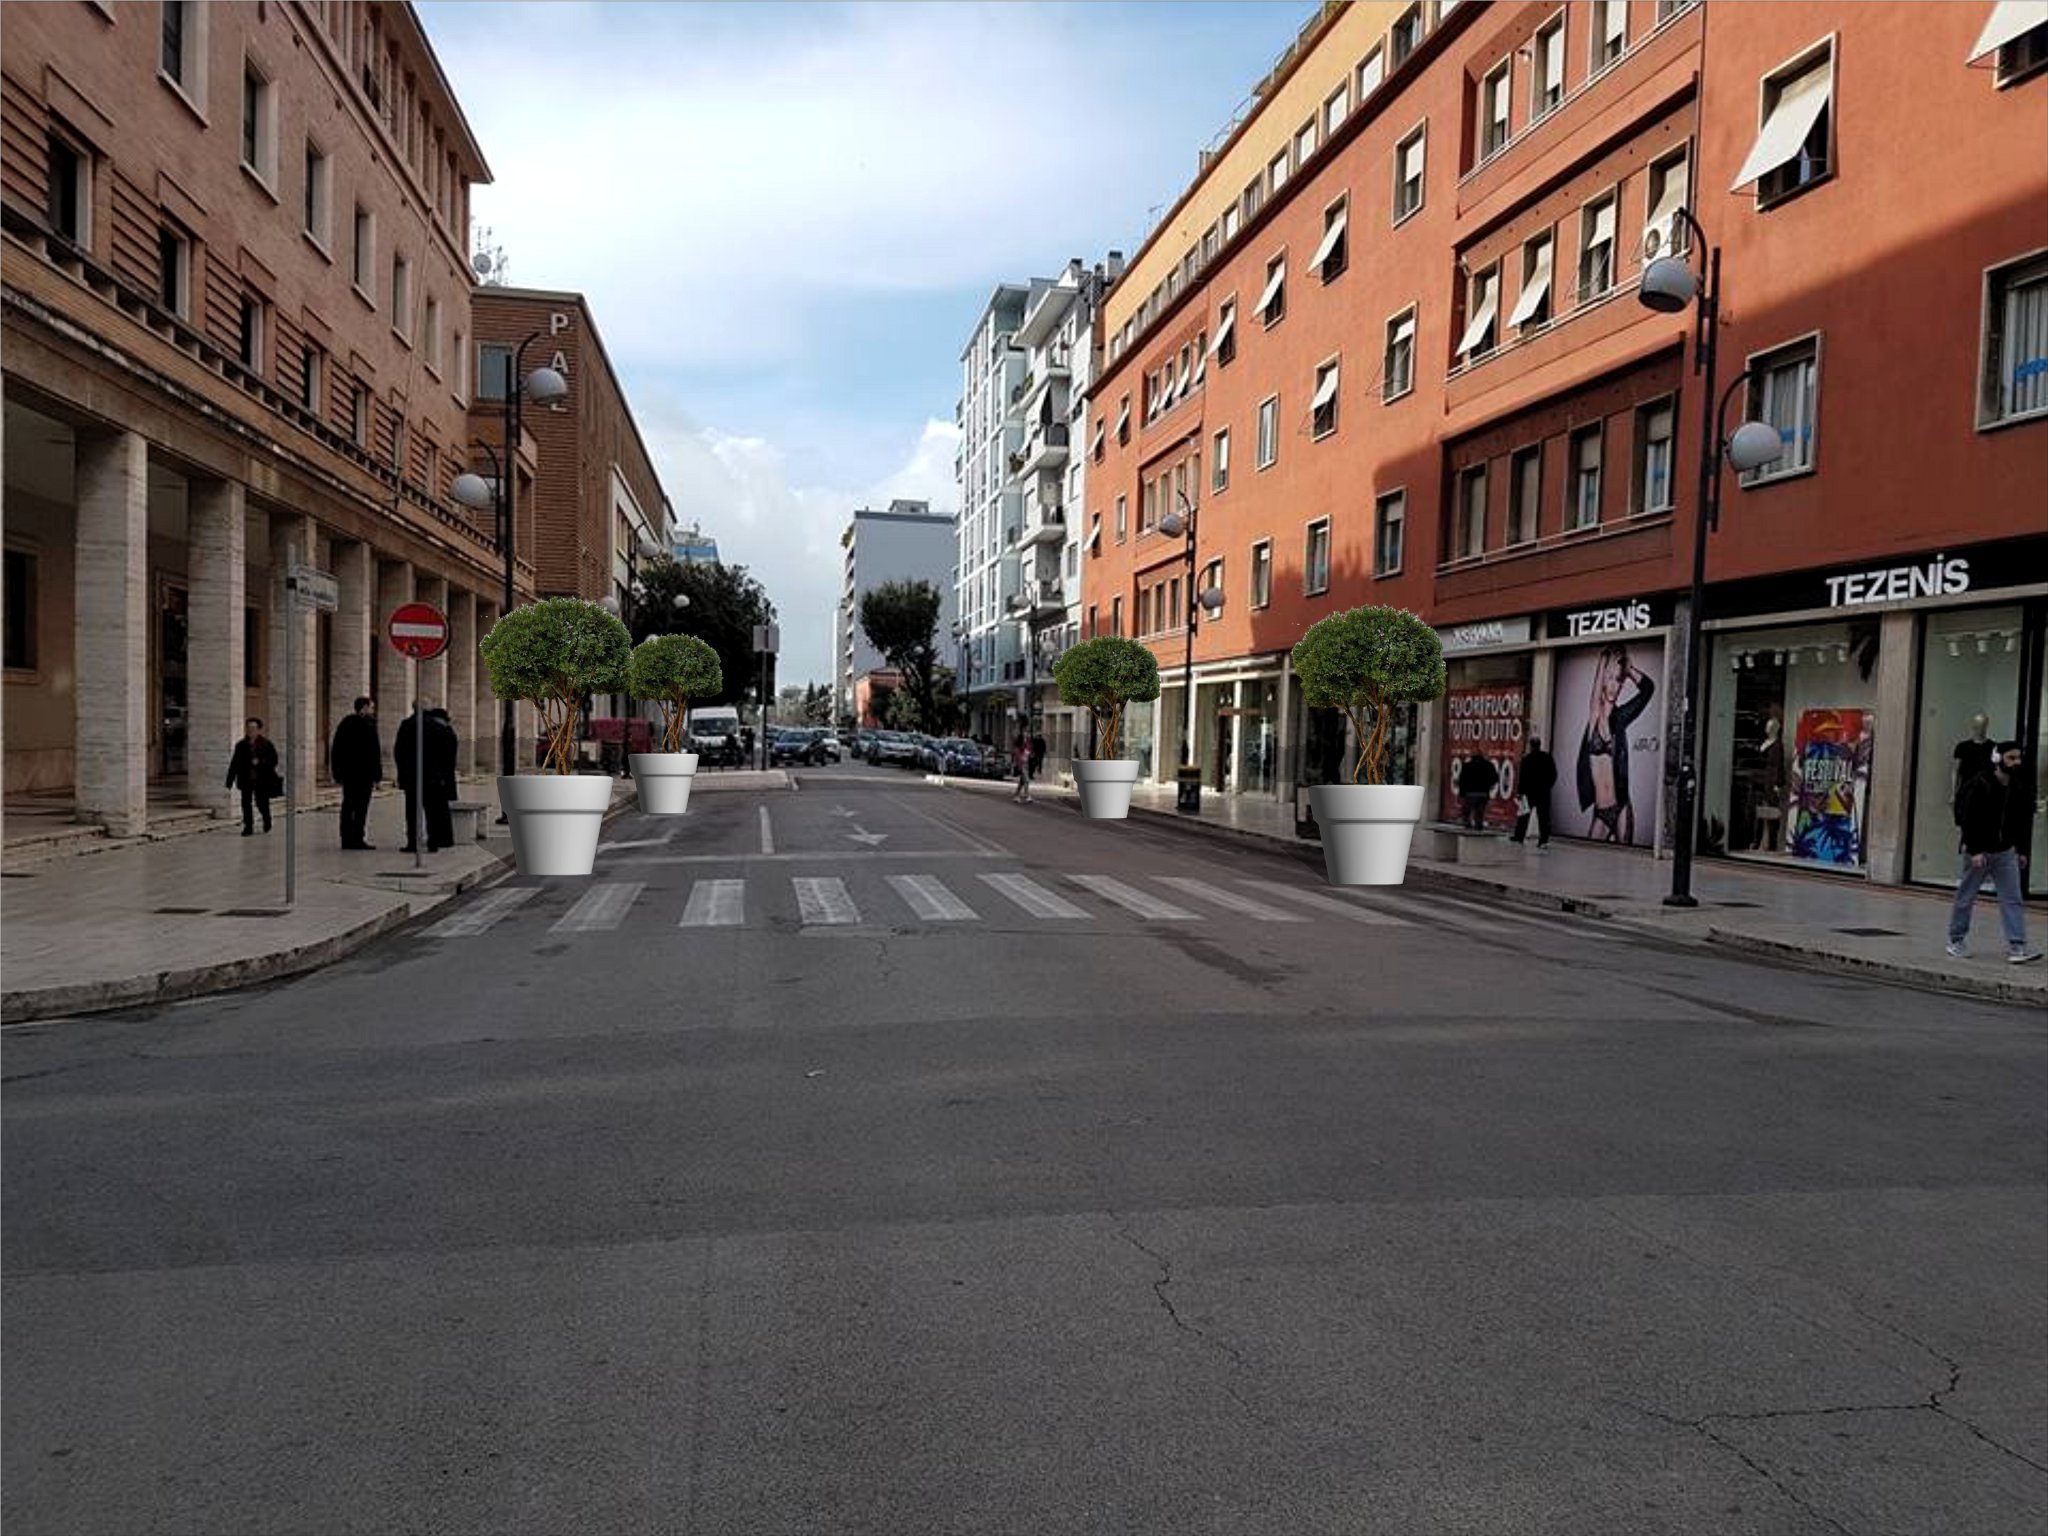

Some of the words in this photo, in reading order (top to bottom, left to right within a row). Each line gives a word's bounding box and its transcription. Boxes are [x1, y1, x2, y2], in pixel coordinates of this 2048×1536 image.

[1825, 553, 1970, 607] TEZENIS
[1566, 599, 1651, 637] TEZENIS
[1484, 718, 1523, 741] TUTTO
